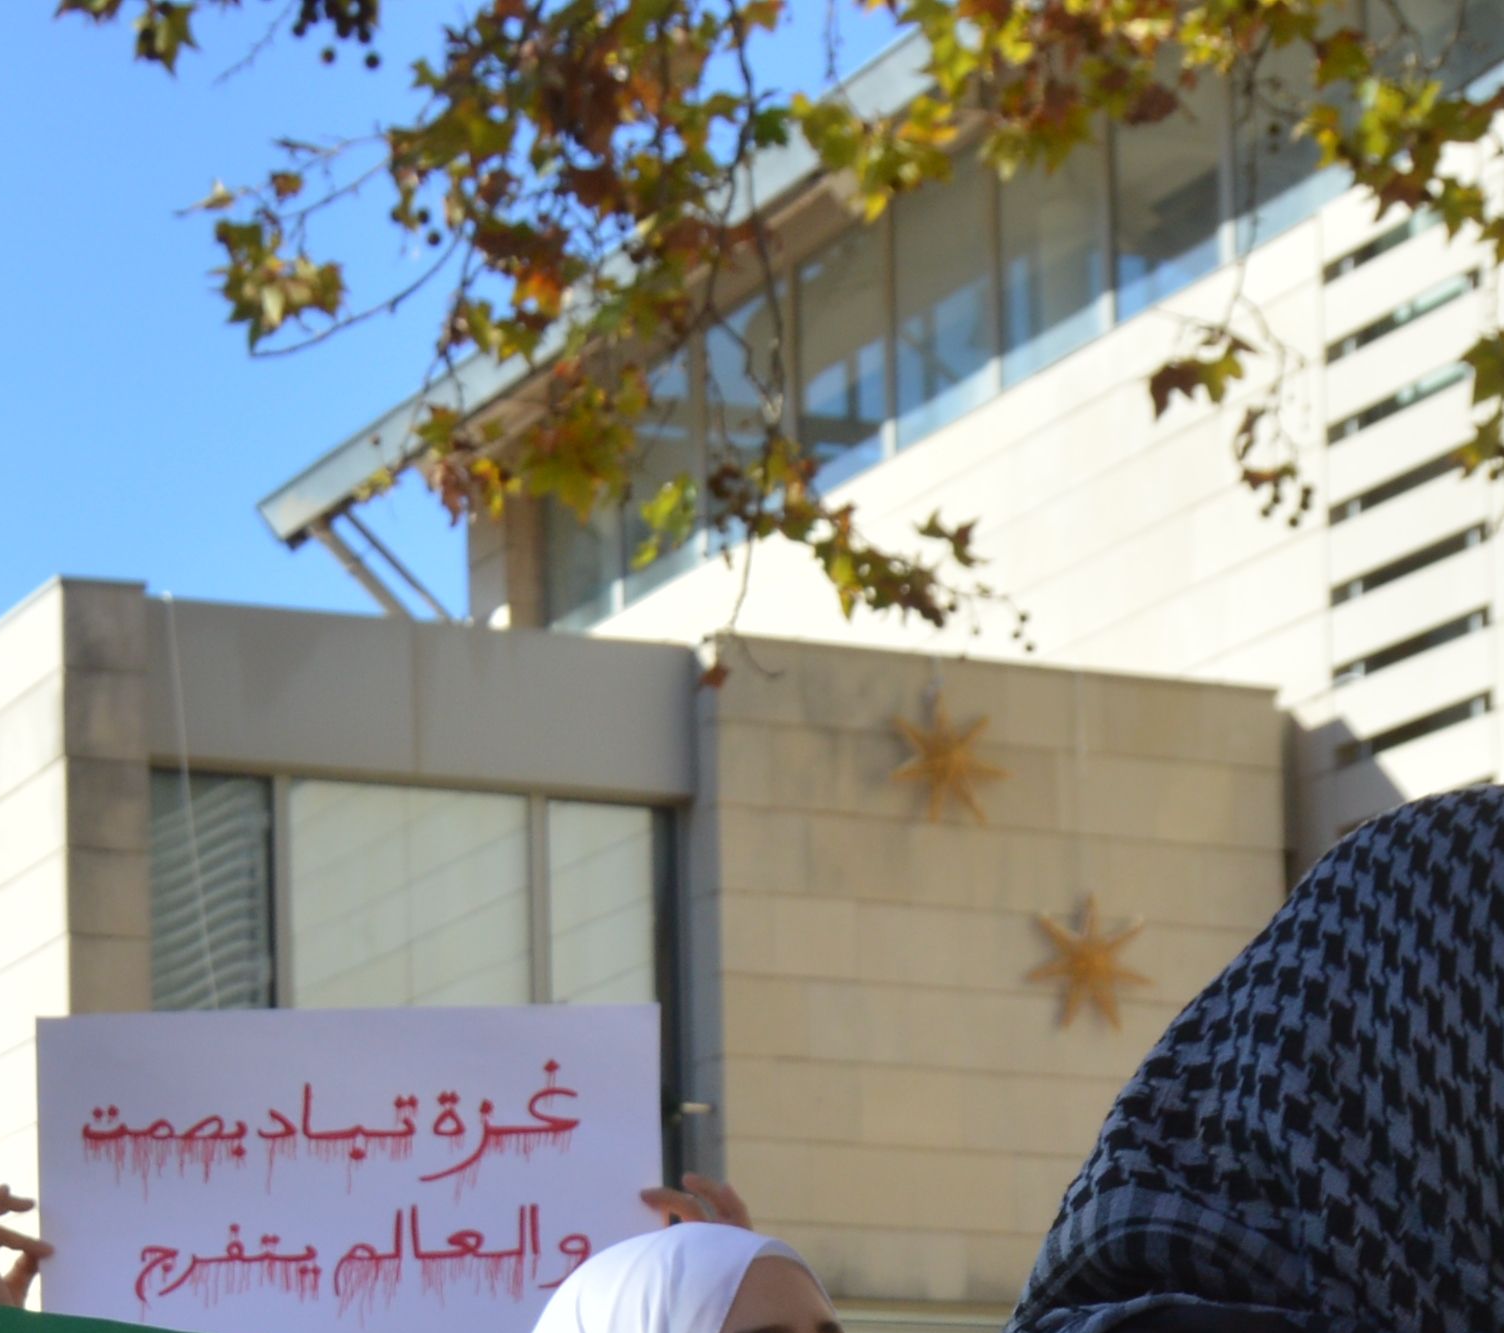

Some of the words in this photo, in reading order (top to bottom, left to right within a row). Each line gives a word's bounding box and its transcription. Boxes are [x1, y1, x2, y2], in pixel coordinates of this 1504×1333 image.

[81, 1104, 248, 1165] بصمت
[257, 1081, 418, 1162] تباد
[419, 1059, 581, 1182] غزة
[134, 1223, 323, 1302] يتفرج
